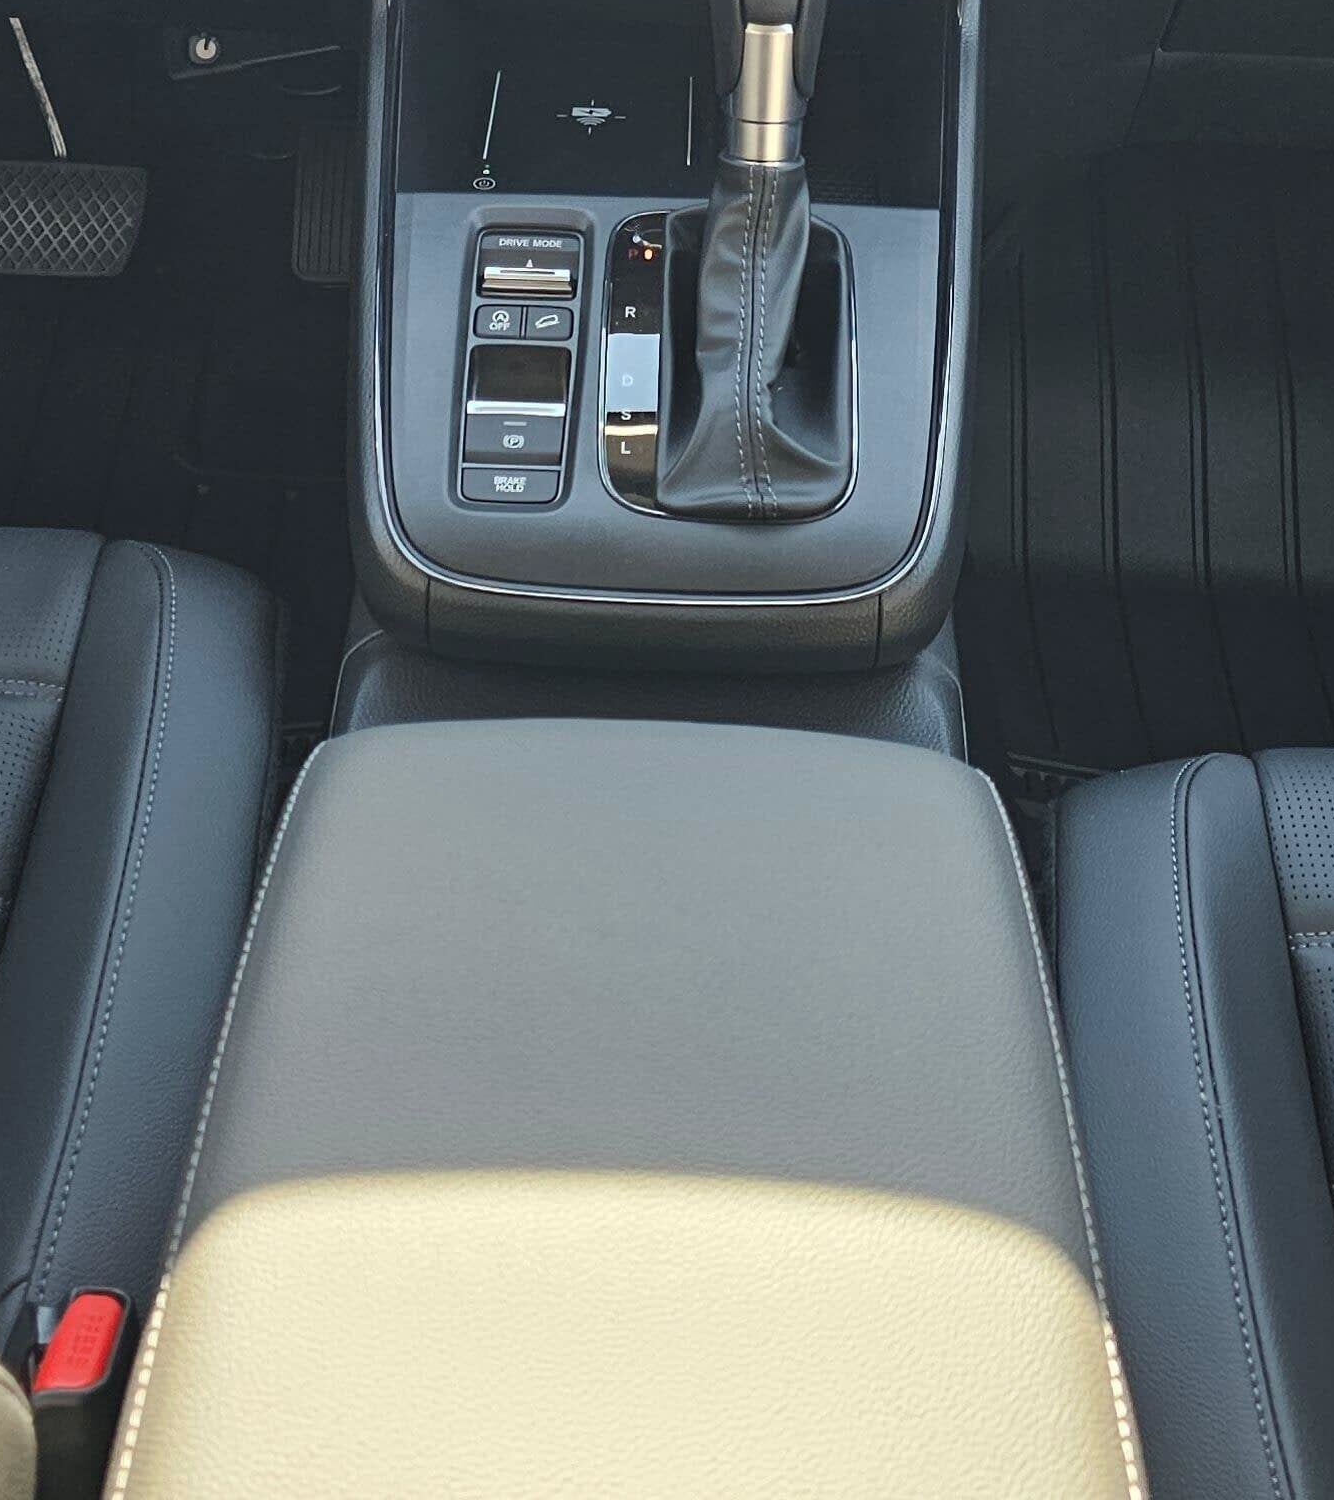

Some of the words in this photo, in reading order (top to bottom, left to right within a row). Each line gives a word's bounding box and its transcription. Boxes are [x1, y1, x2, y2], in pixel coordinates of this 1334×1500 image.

[498, 237, 530, 248] DRIVE
[533, 239, 563, 249] MODE
[625, 306, 636, 318] R
[489, 320, 510, 331] OFF
[621, 376, 633, 387] D
[621, 410, 632, 421] S
[621, 441, 631, 455] L
[493, 475, 526, 486] BRAKE
[495, 483, 525, 493] HOLD
